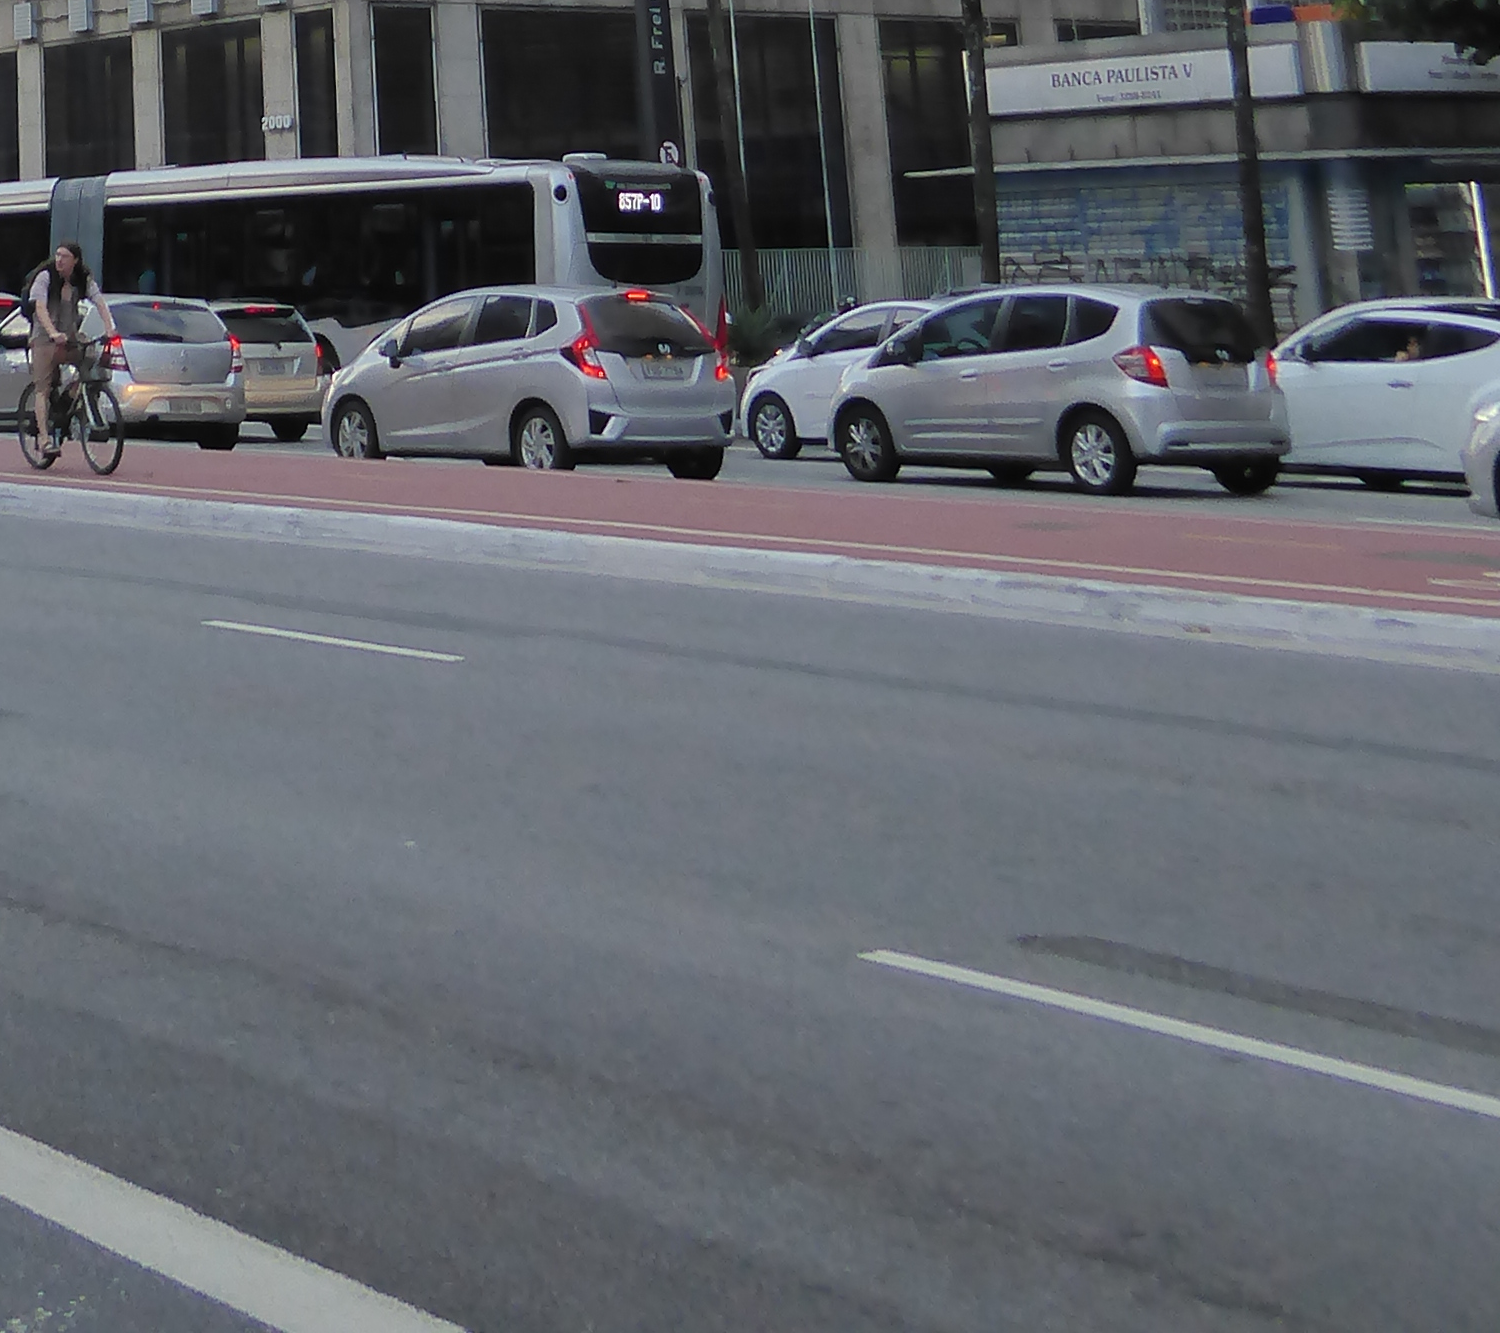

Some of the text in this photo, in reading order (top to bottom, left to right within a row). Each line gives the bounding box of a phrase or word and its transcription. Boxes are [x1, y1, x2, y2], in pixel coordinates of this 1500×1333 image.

[649, 7, 664, 50] Frei
[654, 57, 666, 75] R.
[1051, 62, 1193, 88] BANCA PAULISTA V
[261, 114, 292, 132] 2000
[619, 192, 661, 211] 857P-10
